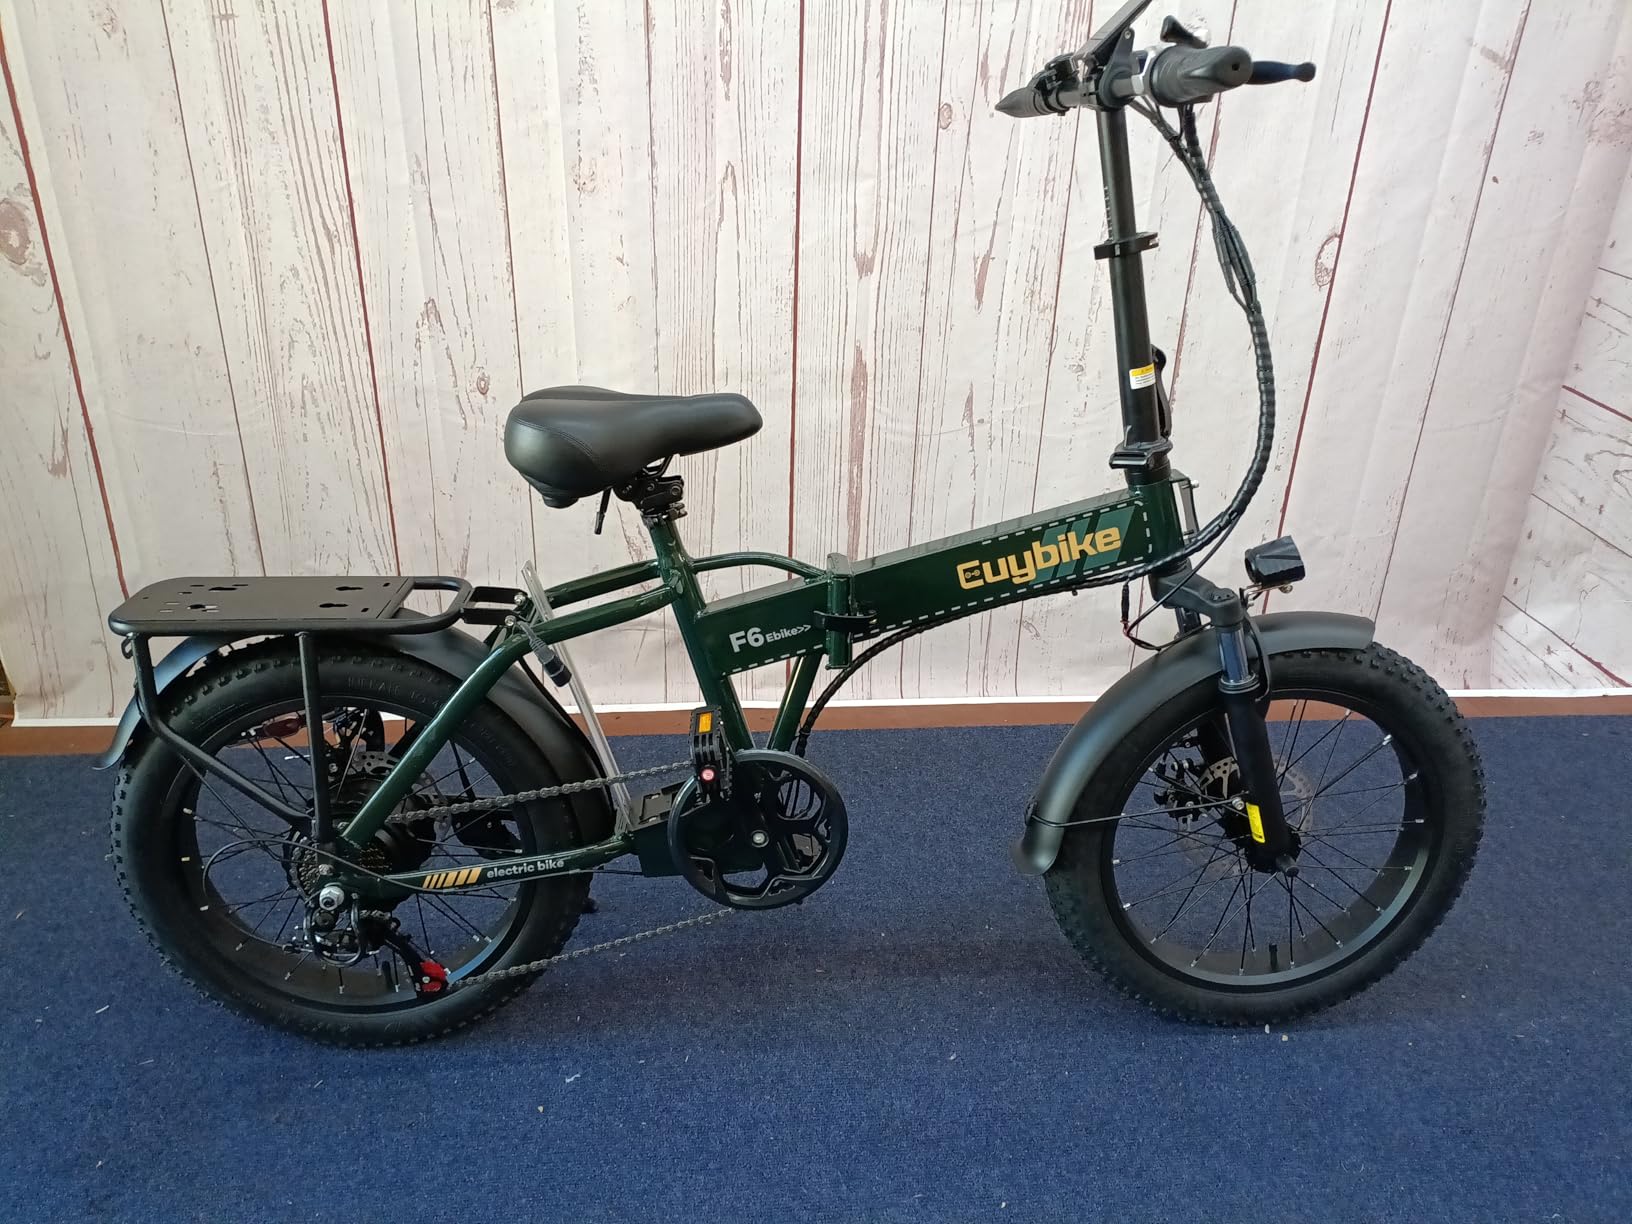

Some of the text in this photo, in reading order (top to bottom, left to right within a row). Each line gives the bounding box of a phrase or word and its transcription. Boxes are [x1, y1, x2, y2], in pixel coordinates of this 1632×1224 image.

[729, 627, 765, 653] F6
[487, 859, 564, 879] electric bike
